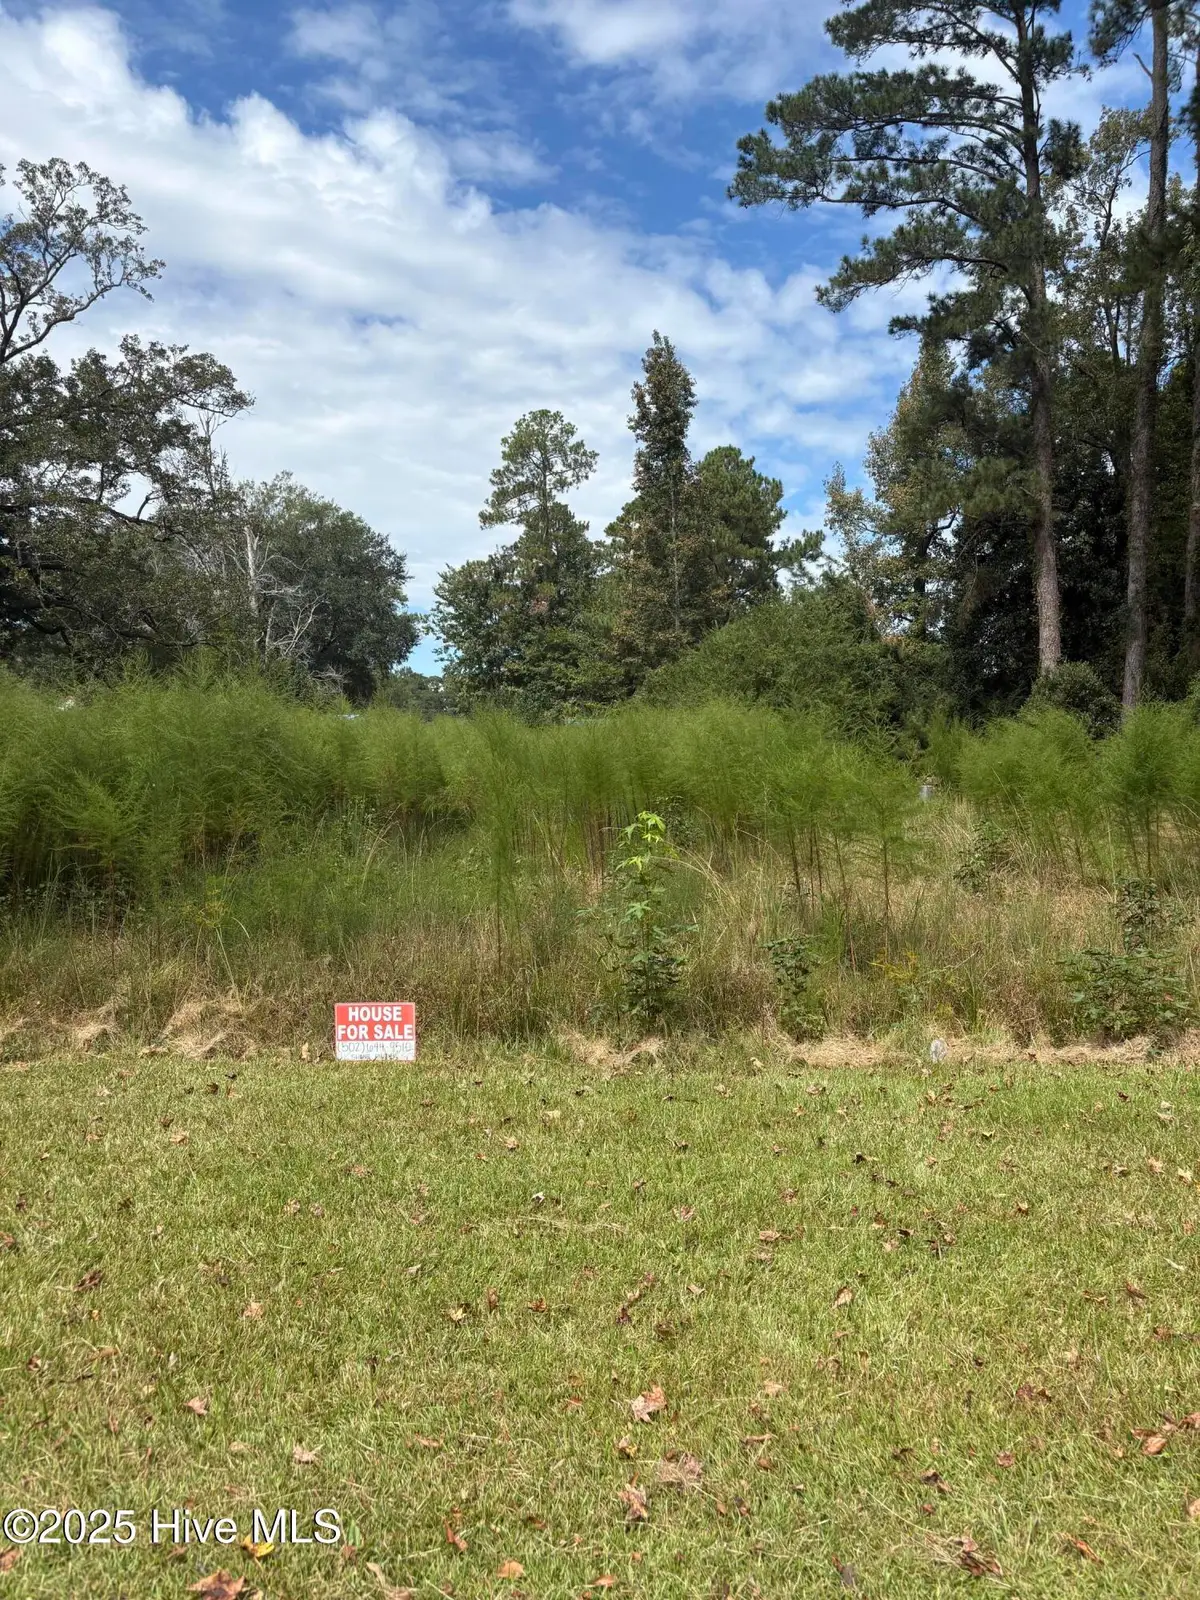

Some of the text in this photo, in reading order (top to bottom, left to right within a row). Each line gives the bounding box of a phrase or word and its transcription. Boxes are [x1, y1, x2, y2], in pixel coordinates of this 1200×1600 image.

[348, 1006, 402, 1022] HOUSE
[337, 1024, 413, 1040] FOR SALE
